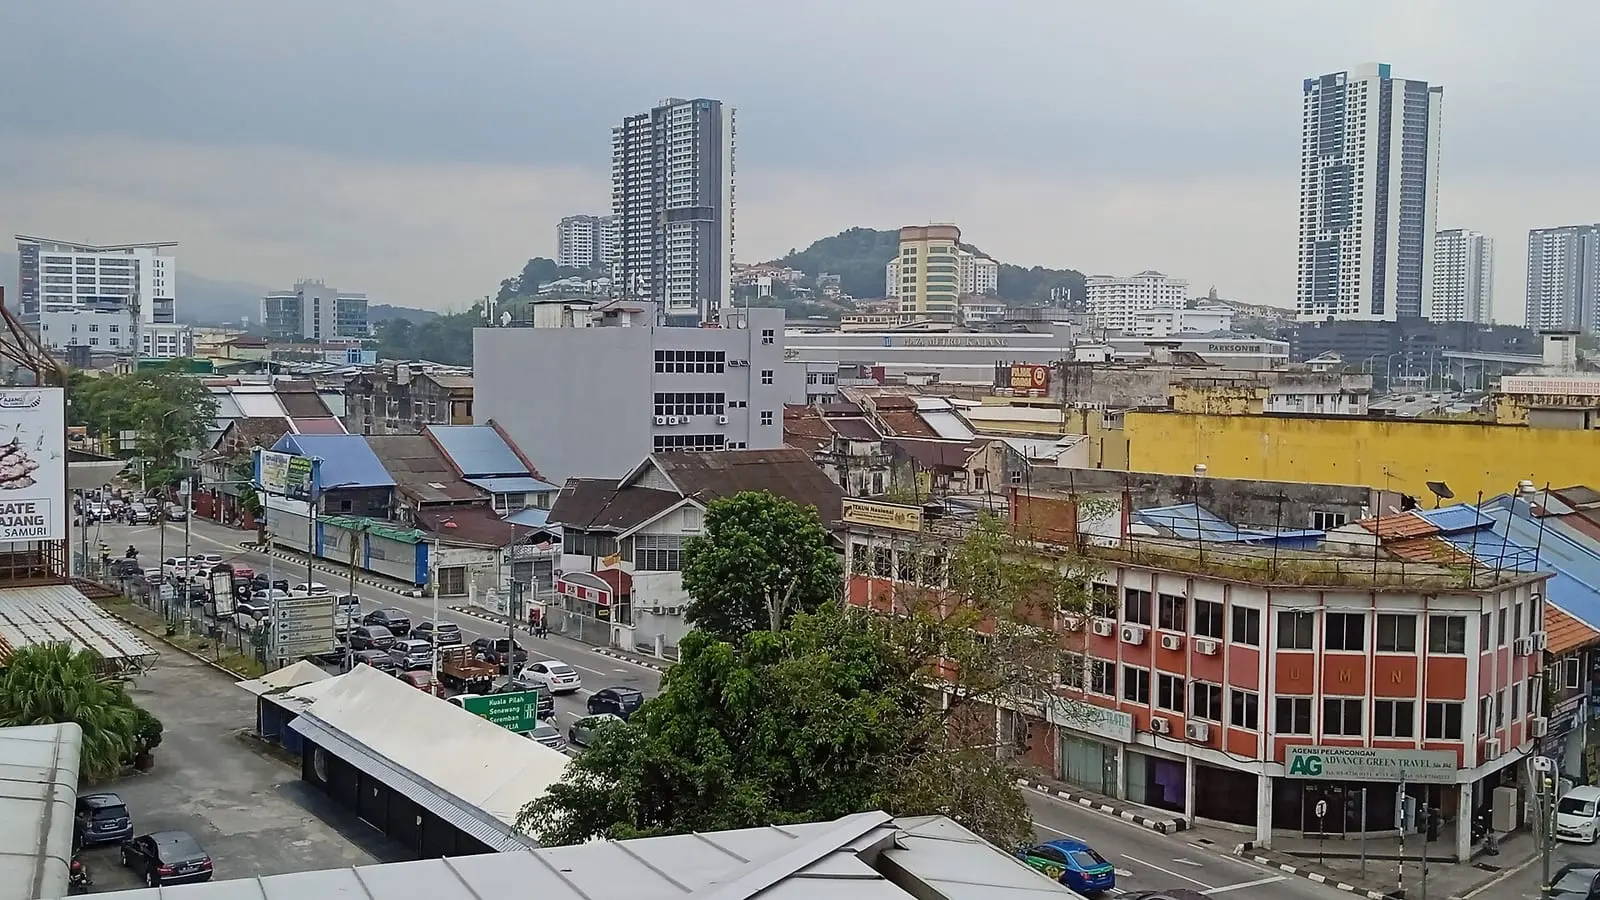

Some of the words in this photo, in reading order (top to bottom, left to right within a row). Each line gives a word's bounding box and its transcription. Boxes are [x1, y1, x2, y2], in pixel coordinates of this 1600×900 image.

[927, 337, 961, 347] METRO
[966, 337, 1008, 347] KAJANG
[4, 527, 47, 537] SAMURI
[1289, 668, 1300, 680] U
[1340, 669, 1351, 682] M
[1391, 671, 1402, 684] N
[508, 696, 525, 704] Pilah
[489, 706, 520, 715] Senawang
[1321, 749, 1376, 757] PELANCONGAN
[1290, 755, 1322, 776] AG
[1325, 756, 1364, 765] ADVANCE
[1366, 757, 1396, 766] GREEN
[1398, 758, 1431, 768] TRAVEL
